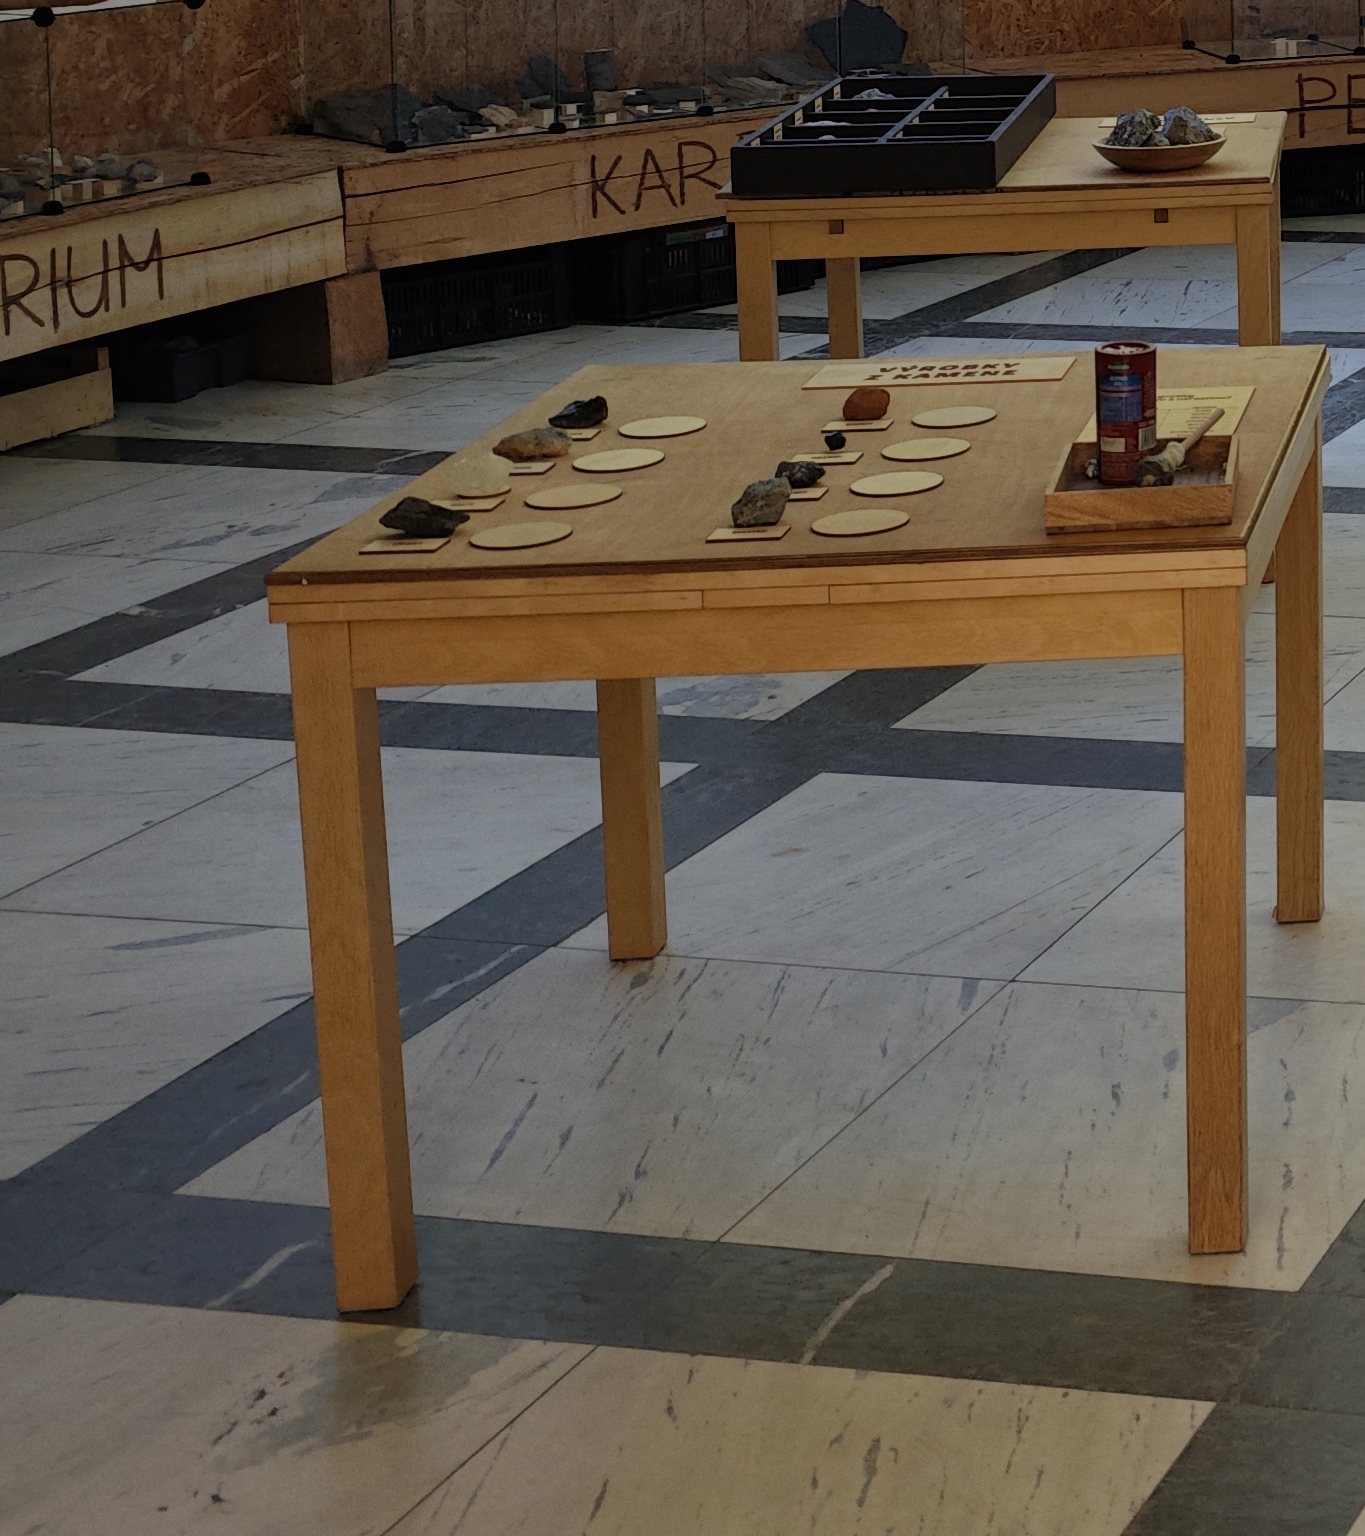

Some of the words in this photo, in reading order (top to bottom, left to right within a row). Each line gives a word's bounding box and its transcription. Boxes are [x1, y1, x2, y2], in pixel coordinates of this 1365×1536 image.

[590, 130, 757, 219] KAR
[0, 227, 164, 336] RIUM
[892, 369, 1019, 381] KAMENE
